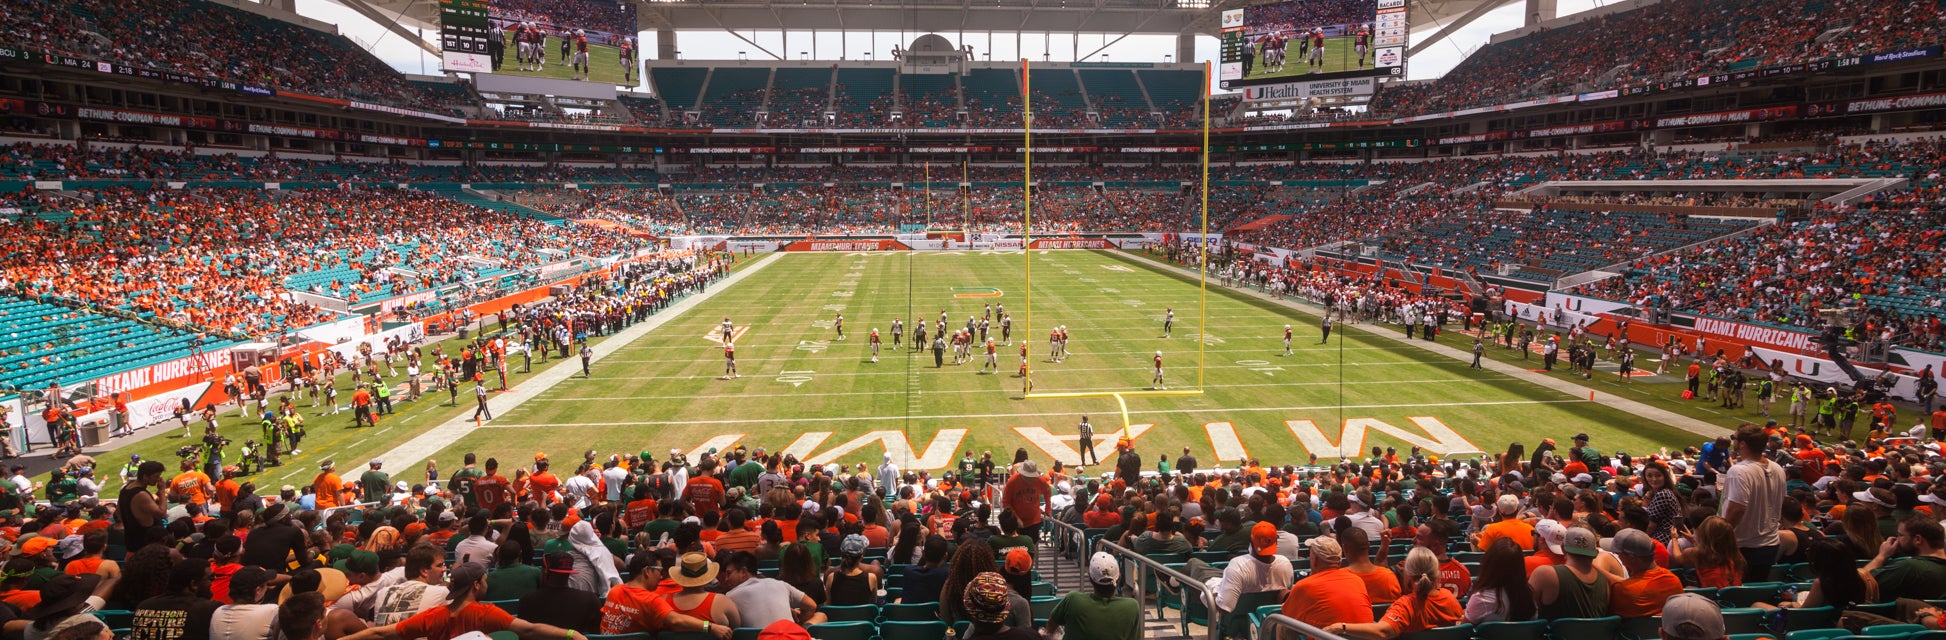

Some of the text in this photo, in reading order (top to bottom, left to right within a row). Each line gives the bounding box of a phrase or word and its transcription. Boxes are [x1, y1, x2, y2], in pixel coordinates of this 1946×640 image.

[446, 40, 455, 48] 1ST
[24, 52, 30, 60] 3
[1902, 50, 1926, 58] Stadium
[64, 59, 90, 68] MIA 24
[1837, 57, 1860, 67] 1:58 PM
[119, 66, 132, 75] 2:18
[1310, 82, 1340, 90] UNIVERSITY
[1246, 84, 1298, 100] UHealth
[1309, 88, 1330, 96] HEALTH
[1848, 95, 1946, 112] BETHUNE-COOKMAN
[78, 108, 153, 123] BETHUNE-COOKMAN
[160, 116, 180, 126] MIAMI
[1657, 114, 1720, 127] BETHUNE-COOKMAN
[1728, 112, 1750, 121] MIAMI
[1530, 127, 1575, 137] BETHUNE-COOKMAN
[1579, 126, 1594, 134] MIAMI
[1038, 241, 1063, 249] MIAMI
[1694, 318, 1736, 336] MIAMI
[98, 350, 232, 397] MIAMI HURRICANES
[460, 481, 470, 493] 5
[484, 489, 494, 503] 0
[134, 609, 188, 617] OPERATION:
[133, 617, 186, 626] CAPTURE
